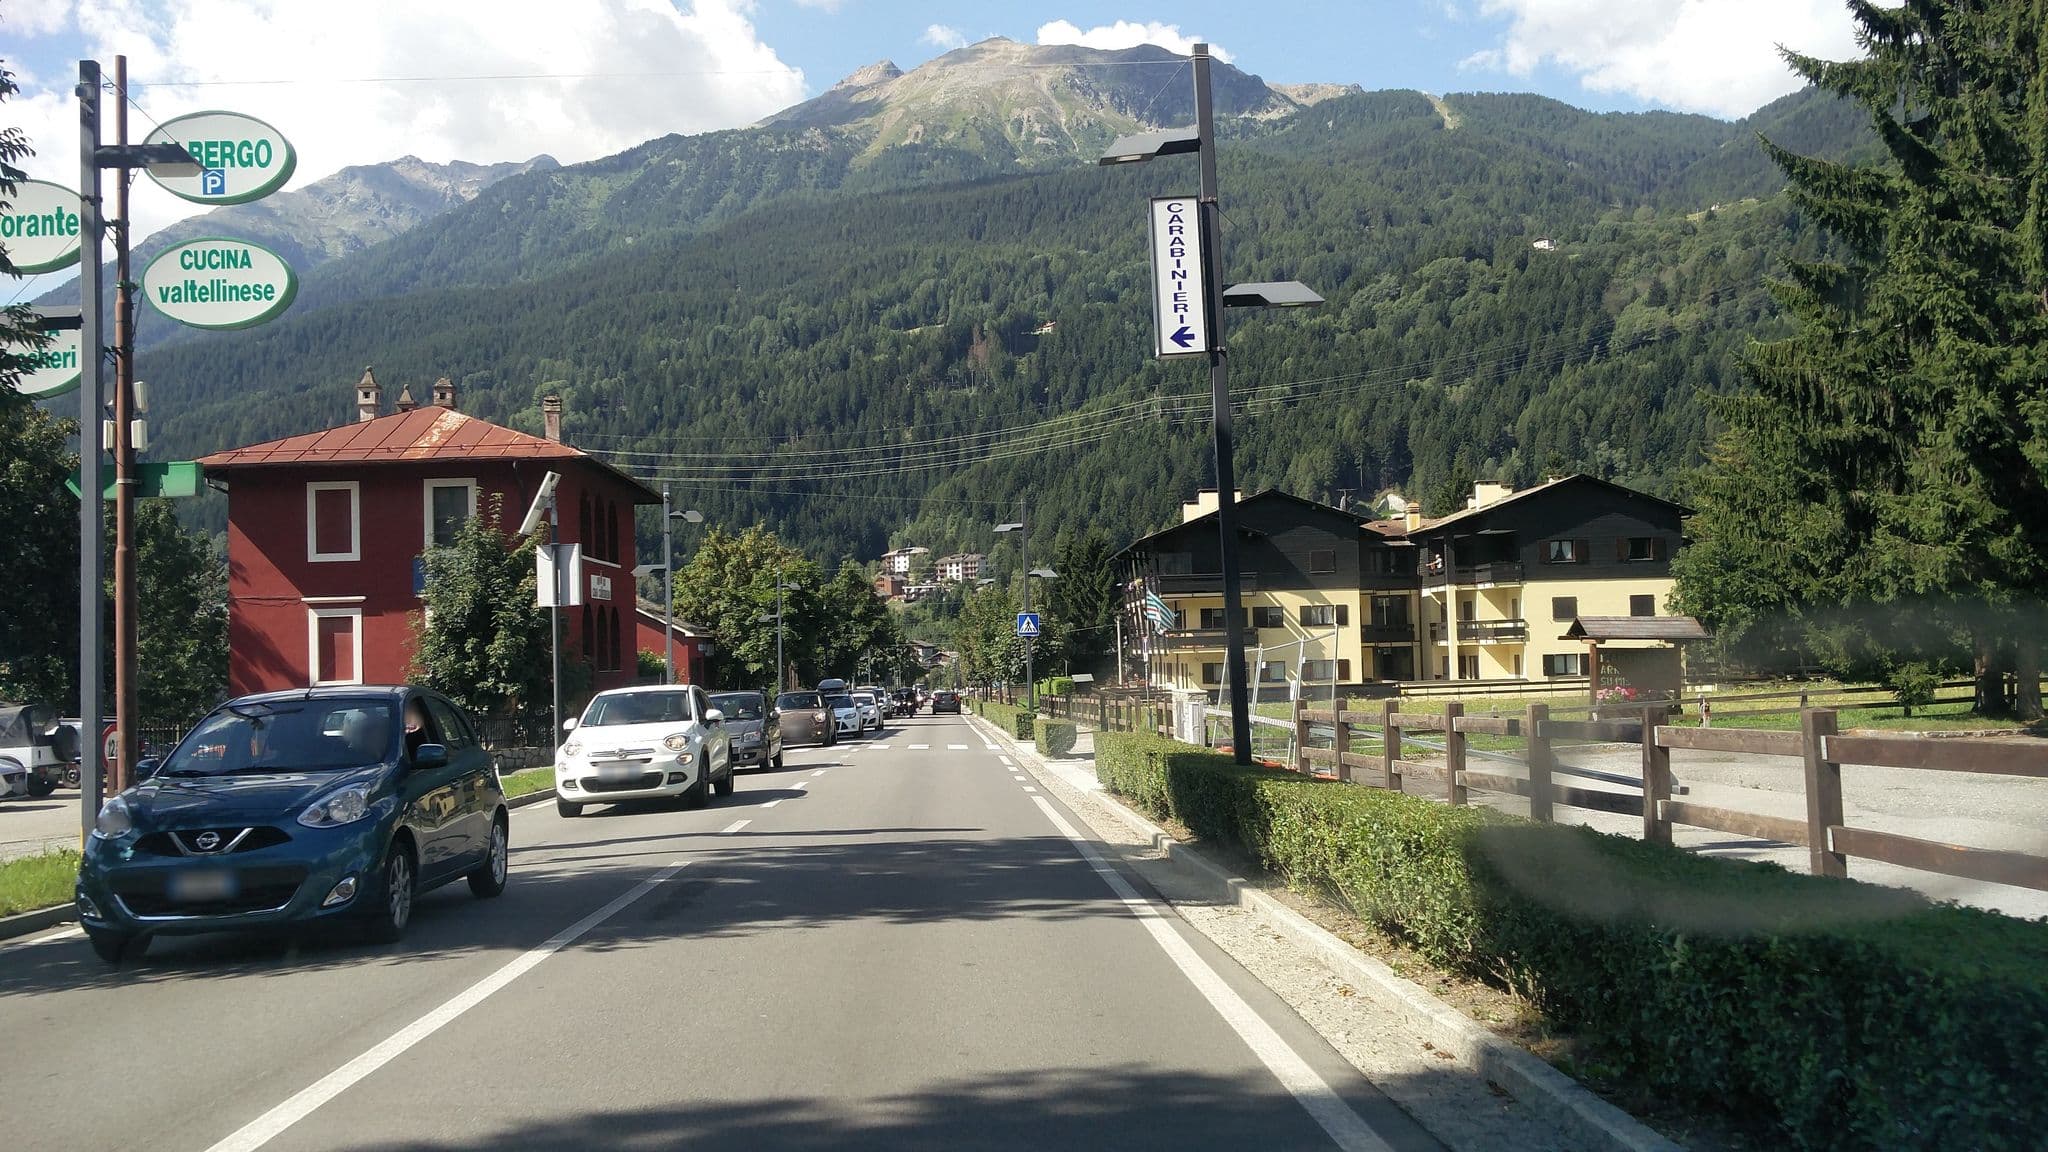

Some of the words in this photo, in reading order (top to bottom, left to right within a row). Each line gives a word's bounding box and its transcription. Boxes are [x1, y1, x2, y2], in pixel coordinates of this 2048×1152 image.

[161, 140, 273, 169] BERGO
[1, 206, 79, 238] orante
[180, 249, 252, 270] CUCINA
[1166, 202, 1190, 325] CARABINIERI
[159, 279, 275, 304] valtellinese
